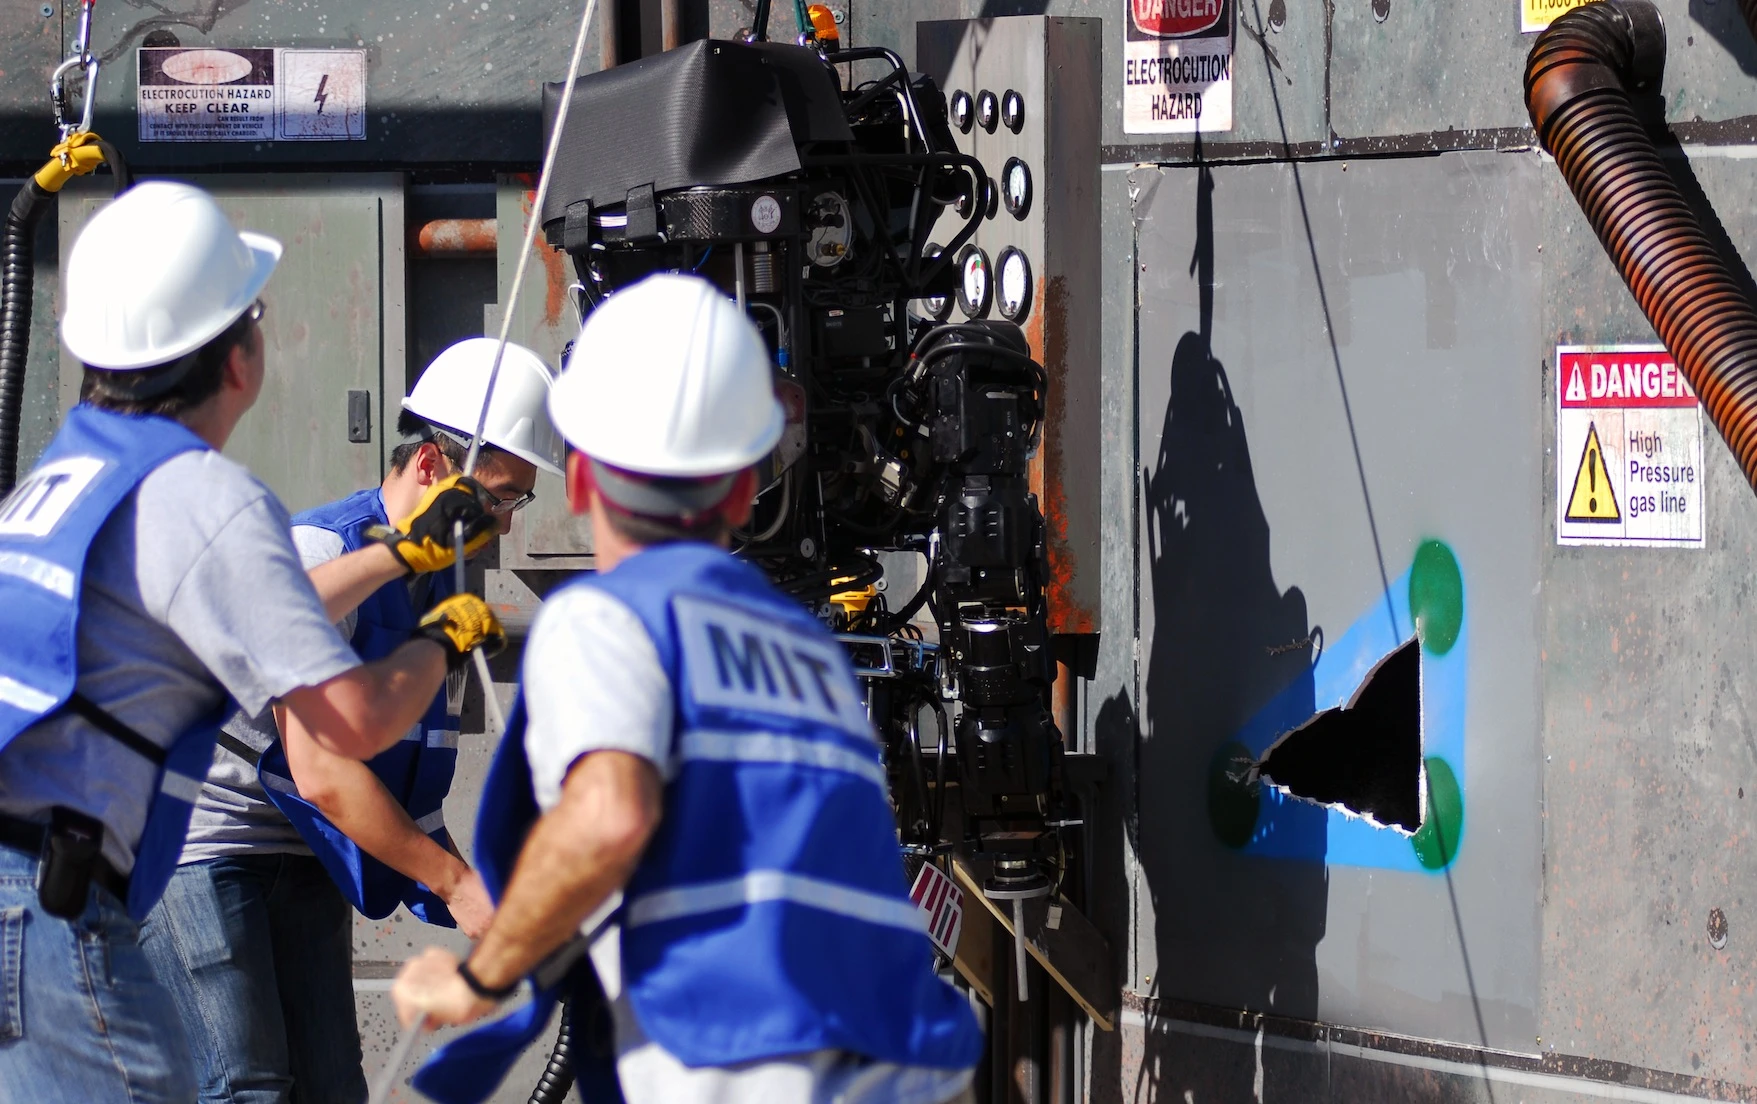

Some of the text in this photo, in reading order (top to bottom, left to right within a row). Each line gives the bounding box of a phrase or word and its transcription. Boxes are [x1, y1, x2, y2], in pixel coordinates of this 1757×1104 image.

[1127, 54, 1230, 85] ELECTROCUTION
[142, 89, 272, 100] ELECTROCUTION HAZARD
[165, 103, 249, 113] KEEP CLEAR
[1152, 92, 1202, 120] HAZARD
[1629, 431, 1662, 458] High
[1630, 461, 1695, 483] Pressure
[1630, 491, 1686, 518] gas line
[706, 622, 838, 714] MIT
